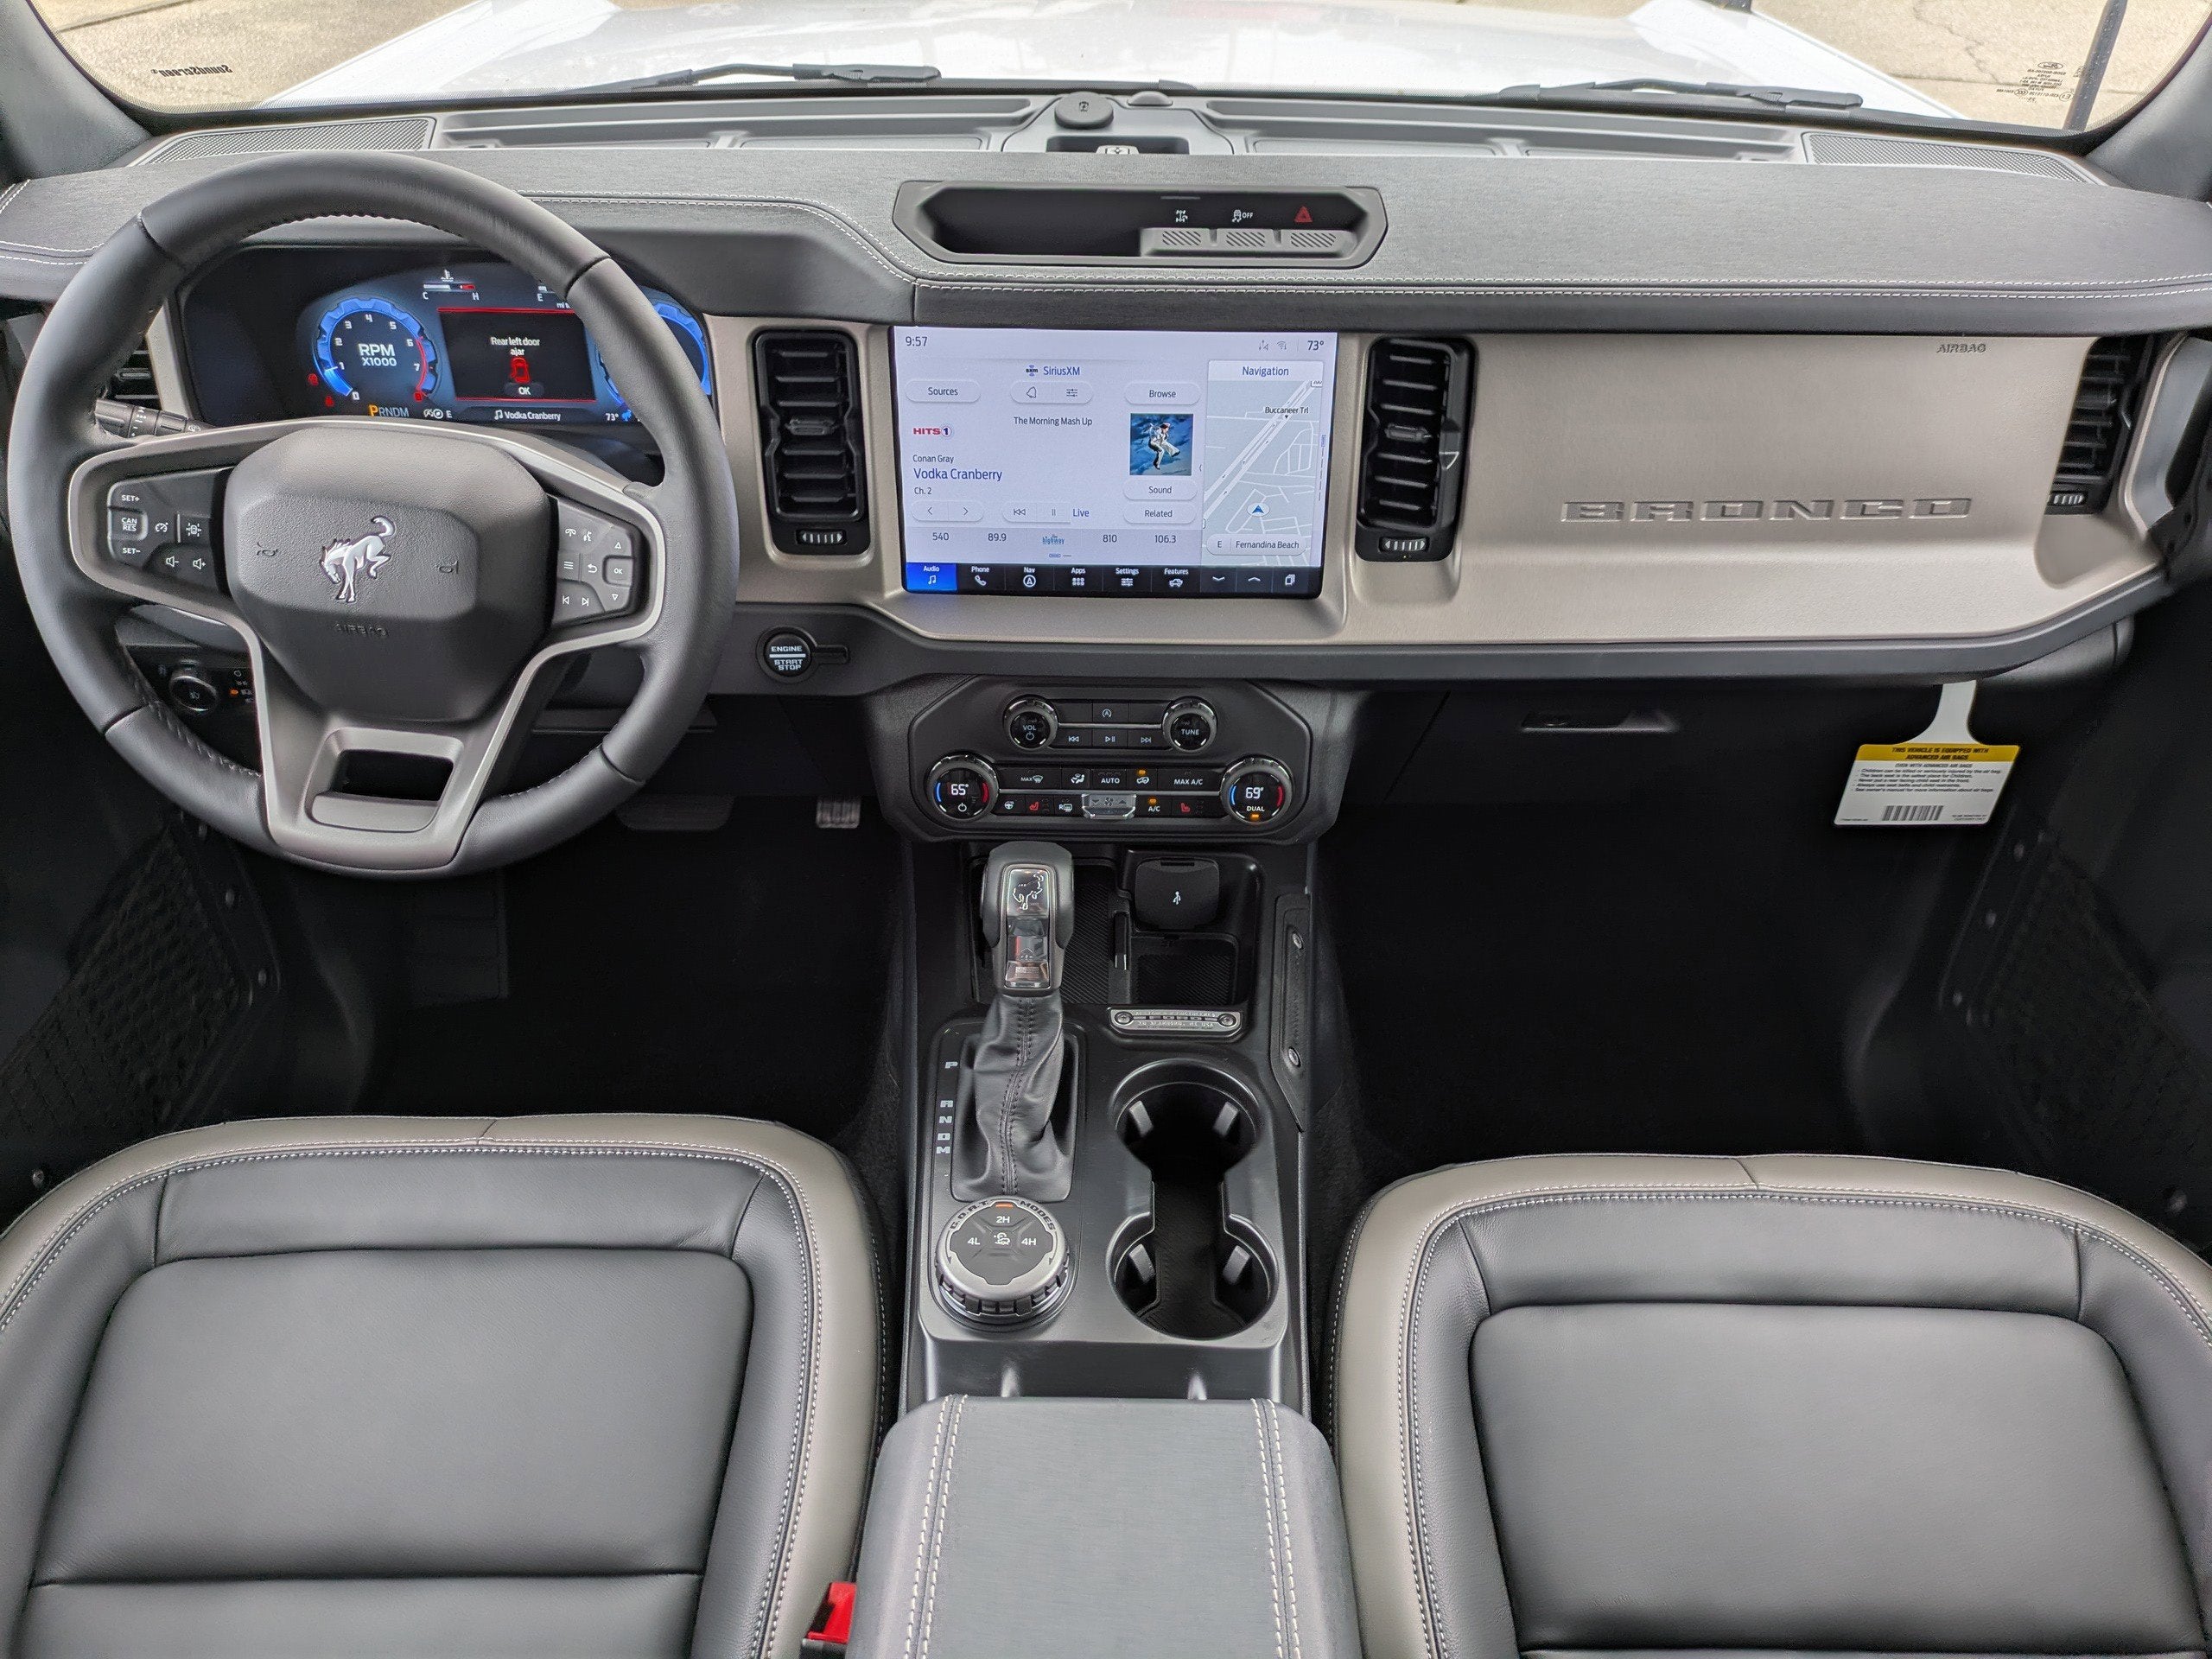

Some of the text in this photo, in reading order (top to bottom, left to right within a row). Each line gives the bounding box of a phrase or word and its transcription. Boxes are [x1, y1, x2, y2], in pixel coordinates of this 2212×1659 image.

[537, 293, 543, 302] E
[365, 315, 373, 323] 4
[345, 321, 353, 329] 3
[389, 321, 397, 330] 5
[334, 338, 343, 346] 2
[406, 339, 414, 347] 6
[490, 337, 541, 347] Rear left door
[905, 335, 928, 347] 9:57
[1307, 340, 1325, 351] 73°
[358, 343, 396, 357] RPM
[510, 347, 525, 357] ajar
[1936, 341, 1987, 355] AIRBAG
[362, 357, 397, 367] X1000
[413, 363, 420, 372] 7
[1043, 365, 1080, 376] SiriusXM
[1242, 365, 1289, 378] Navigation
[352, 391, 360, 400] 0
[518, 386, 531, 396] OK
[927, 387, 958, 397] Sources
[1148, 390, 1177, 398] Browse
[445, 410, 453, 418] E
[1264, 406, 1298, 415] Buccaneer
[504, 411, 561, 422] Vodka Cranberry
[605, 412, 619, 422] 73°
[1014, 416, 1093, 427] The Morning Mash Up
[912, 427, 941, 435] HITS
[912, 454, 955, 464] Conan Gray
[913, 467, 1002, 482] Vodka Cranberry
[913, 486, 932, 495] Ch. 2
[1148, 486, 1173, 494] Sound
[1072, 508, 1090, 518] Live
[1144, 509, 1173, 518] Related
[1560, 497, 1973, 523] BRONCO
[931, 532, 950, 542] 540
[988, 532, 1007, 543] 89.9
[1103, 534, 1118, 543] 810
[1154, 534, 1177, 543] 106.3
[1235, 540, 1276, 549] Fernandina
[1071, 567, 1086, 575] Apps
[950, 783, 969, 797] 65°
[940, 1099, 954, 1108] R
[937, 1132, 951, 1141] D
[936, 1146, 951, 1154] M
[1020, 1200, 1056, 1230] MODES
[967, 1237, 981, 1246] 4L
[1020, 1237, 1037, 1246] 4H
